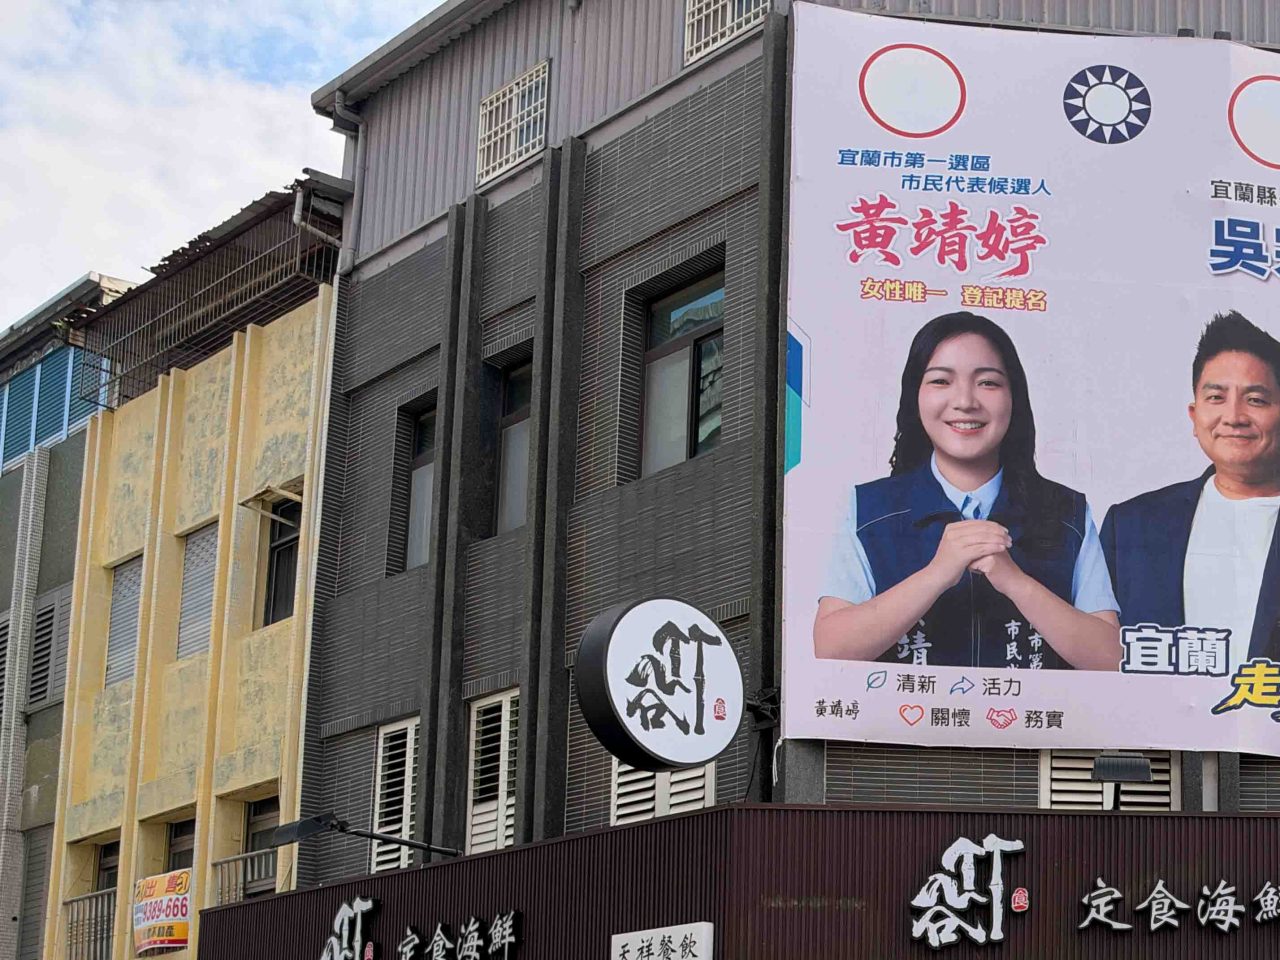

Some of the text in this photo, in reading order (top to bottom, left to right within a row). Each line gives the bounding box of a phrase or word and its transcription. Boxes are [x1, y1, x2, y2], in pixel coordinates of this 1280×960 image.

[838, 149, 991, 172] 宜蘭市第一選區
[901, 174, 1052, 196] 市民代表候選人
[836, 194, 1047, 277] 黃靖婷
[861, 278, 1047, 312] 女性唯一 登記提名
[1121, 626, 1231, 675] 宜蘭
[897, 674, 1021, 697] 清新 活力
[814, 699, 860, 721] 黃靖婷
[931, 708, 1064, 729] 關懷 務實
